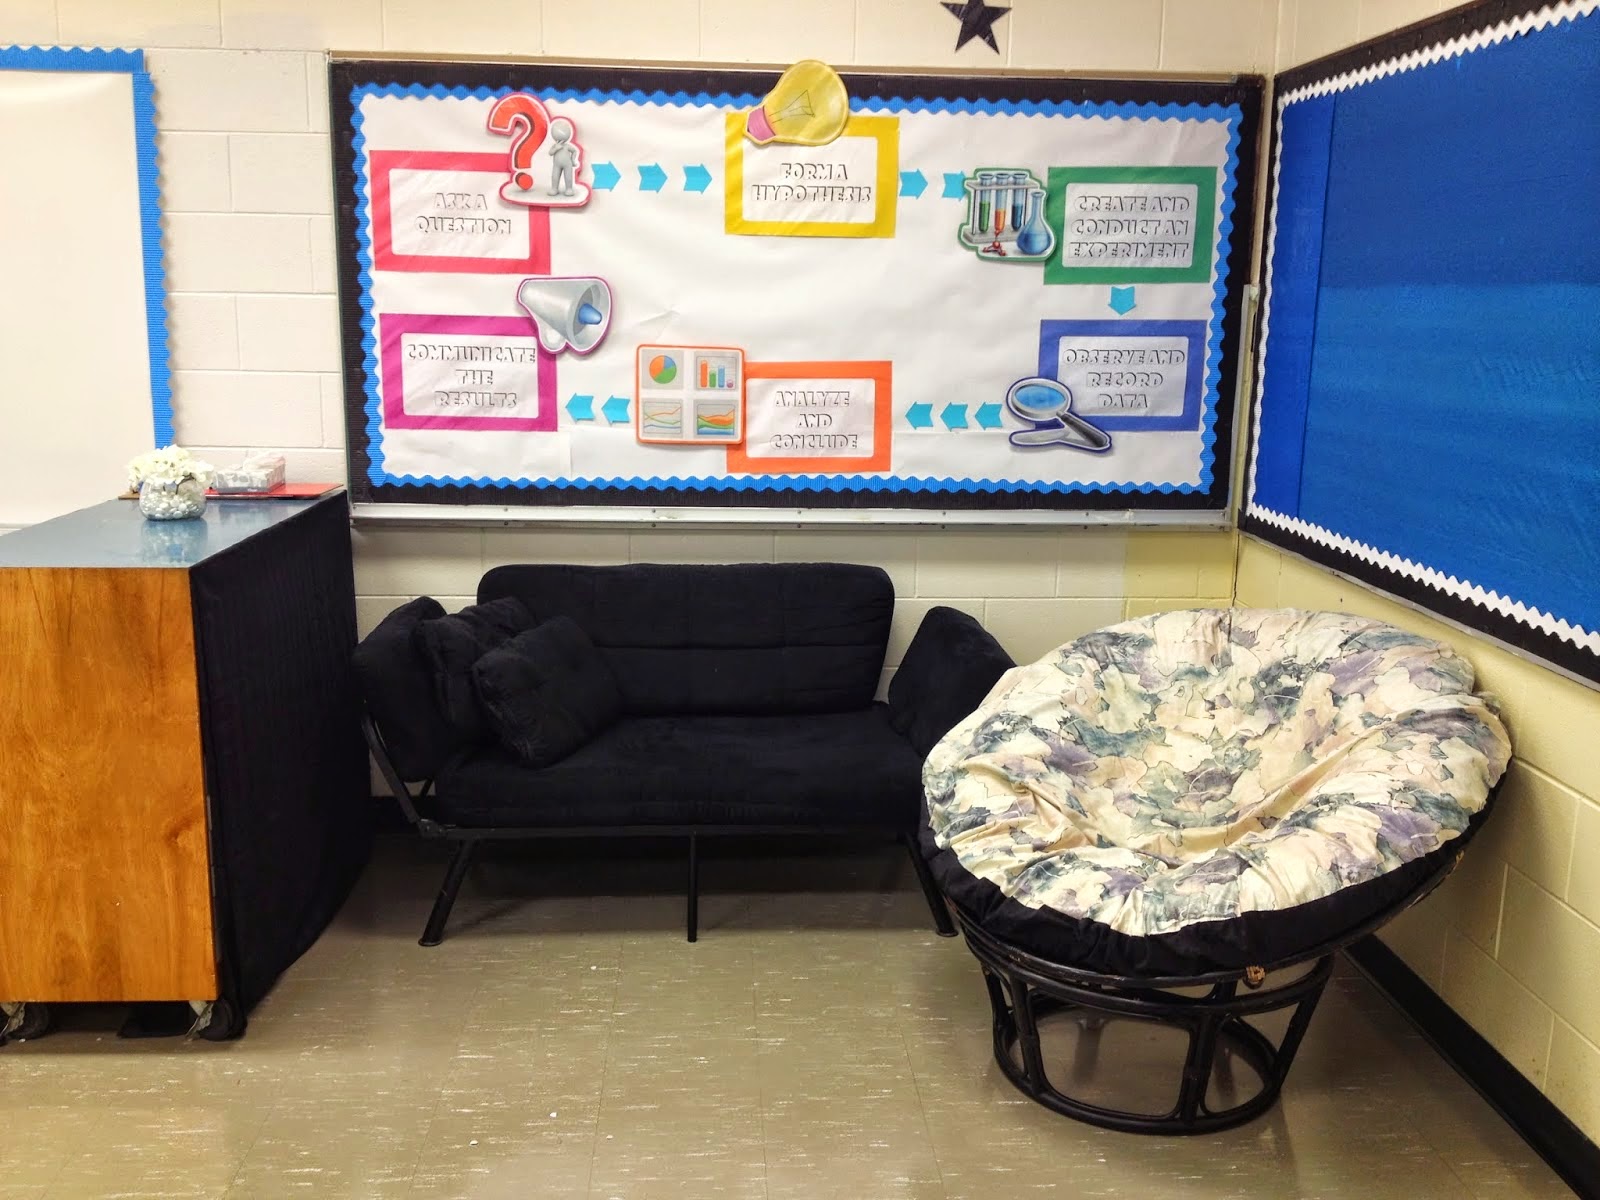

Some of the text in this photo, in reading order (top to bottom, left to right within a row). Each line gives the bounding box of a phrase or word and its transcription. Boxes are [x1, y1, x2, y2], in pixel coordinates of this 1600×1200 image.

[780, 162, 833, 180] FORM
[433, 193, 470, 210] ASK
[752, 184, 872, 203] HYPOTHESIS
[1074, 195, 1190, 213] CREATE AND
[415, 216, 513, 235] QUESTION
[1071, 219, 1189, 236] CONDUCT AN
[1069, 242, 1189, 259] EXPERIMENT
[407, 344, 537, 363] COMMUNICATE
[1063, 348, 1186, 365] OBSERVE AND
[455, 369, 494, 385] THE
[1086, 371, 1164, 388] RECORD
[434, 391, 518, 409] RESULTS
[774, 390, 851, 408] ANALYZE
[1099, 393, 1149, 409] DATA
[796, 413, 833, 429] AND
[769, 433, 859, 450] CONCLUDE
